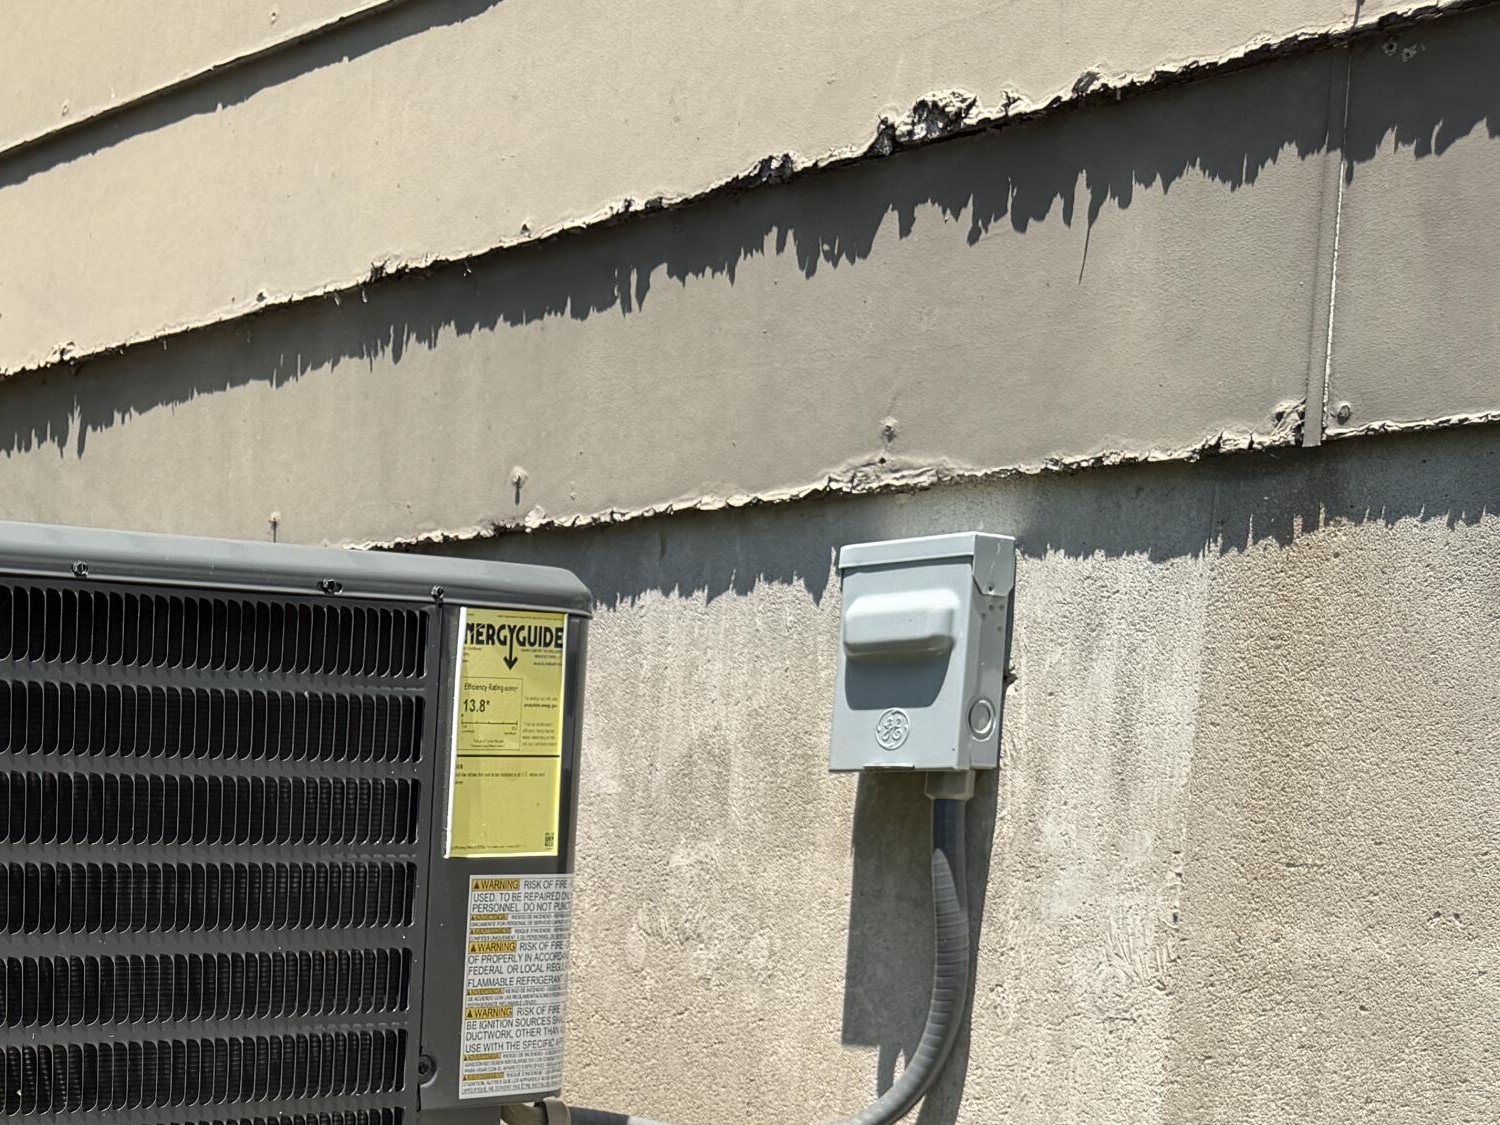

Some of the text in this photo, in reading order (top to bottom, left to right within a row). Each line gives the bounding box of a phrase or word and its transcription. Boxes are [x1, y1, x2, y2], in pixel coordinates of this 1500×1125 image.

[480, 879, 518, 889] WARNING
[524, 880, 541, 889] RISK
[543, 880, 553, 889] OF
[500, 892, 510, 901] TO
[512, 892, 522, 901] BE
[524, 891, 560, 901] REPAIRED
[523, 902, 535, 911] DO
[537, 902, 552, 911] NOT
[477, 941, 515, 951] WARNING
[520, 941, 537, 951] RISK
[539, 941, 549, 950] OF
[468, 955, 479, 964] OF
[469, 965, 504, 975] FEDERAL
[507, 964, 518, 974] OR
[520, 962, 544, 973] LOCAL
[468, 977, 514, 987] FLAMMABLE
[474, 1007, 512, 1017] WARNING
[517, 1006, 534, 1016] RISK
[536, 1005, 546, 1015] OF
[466, 1020, 477, 1030] BE
[479, 1019, 513, 1029] IGNITION
[515, 1016, 550, 1027] SOURCES
[515, 1027, 541, 1038] OTHER
[465, 1043, 481, 1053] USE
[483, 1042, 503, 1052] WITH
[506, 1040, 520, 1050] THE
